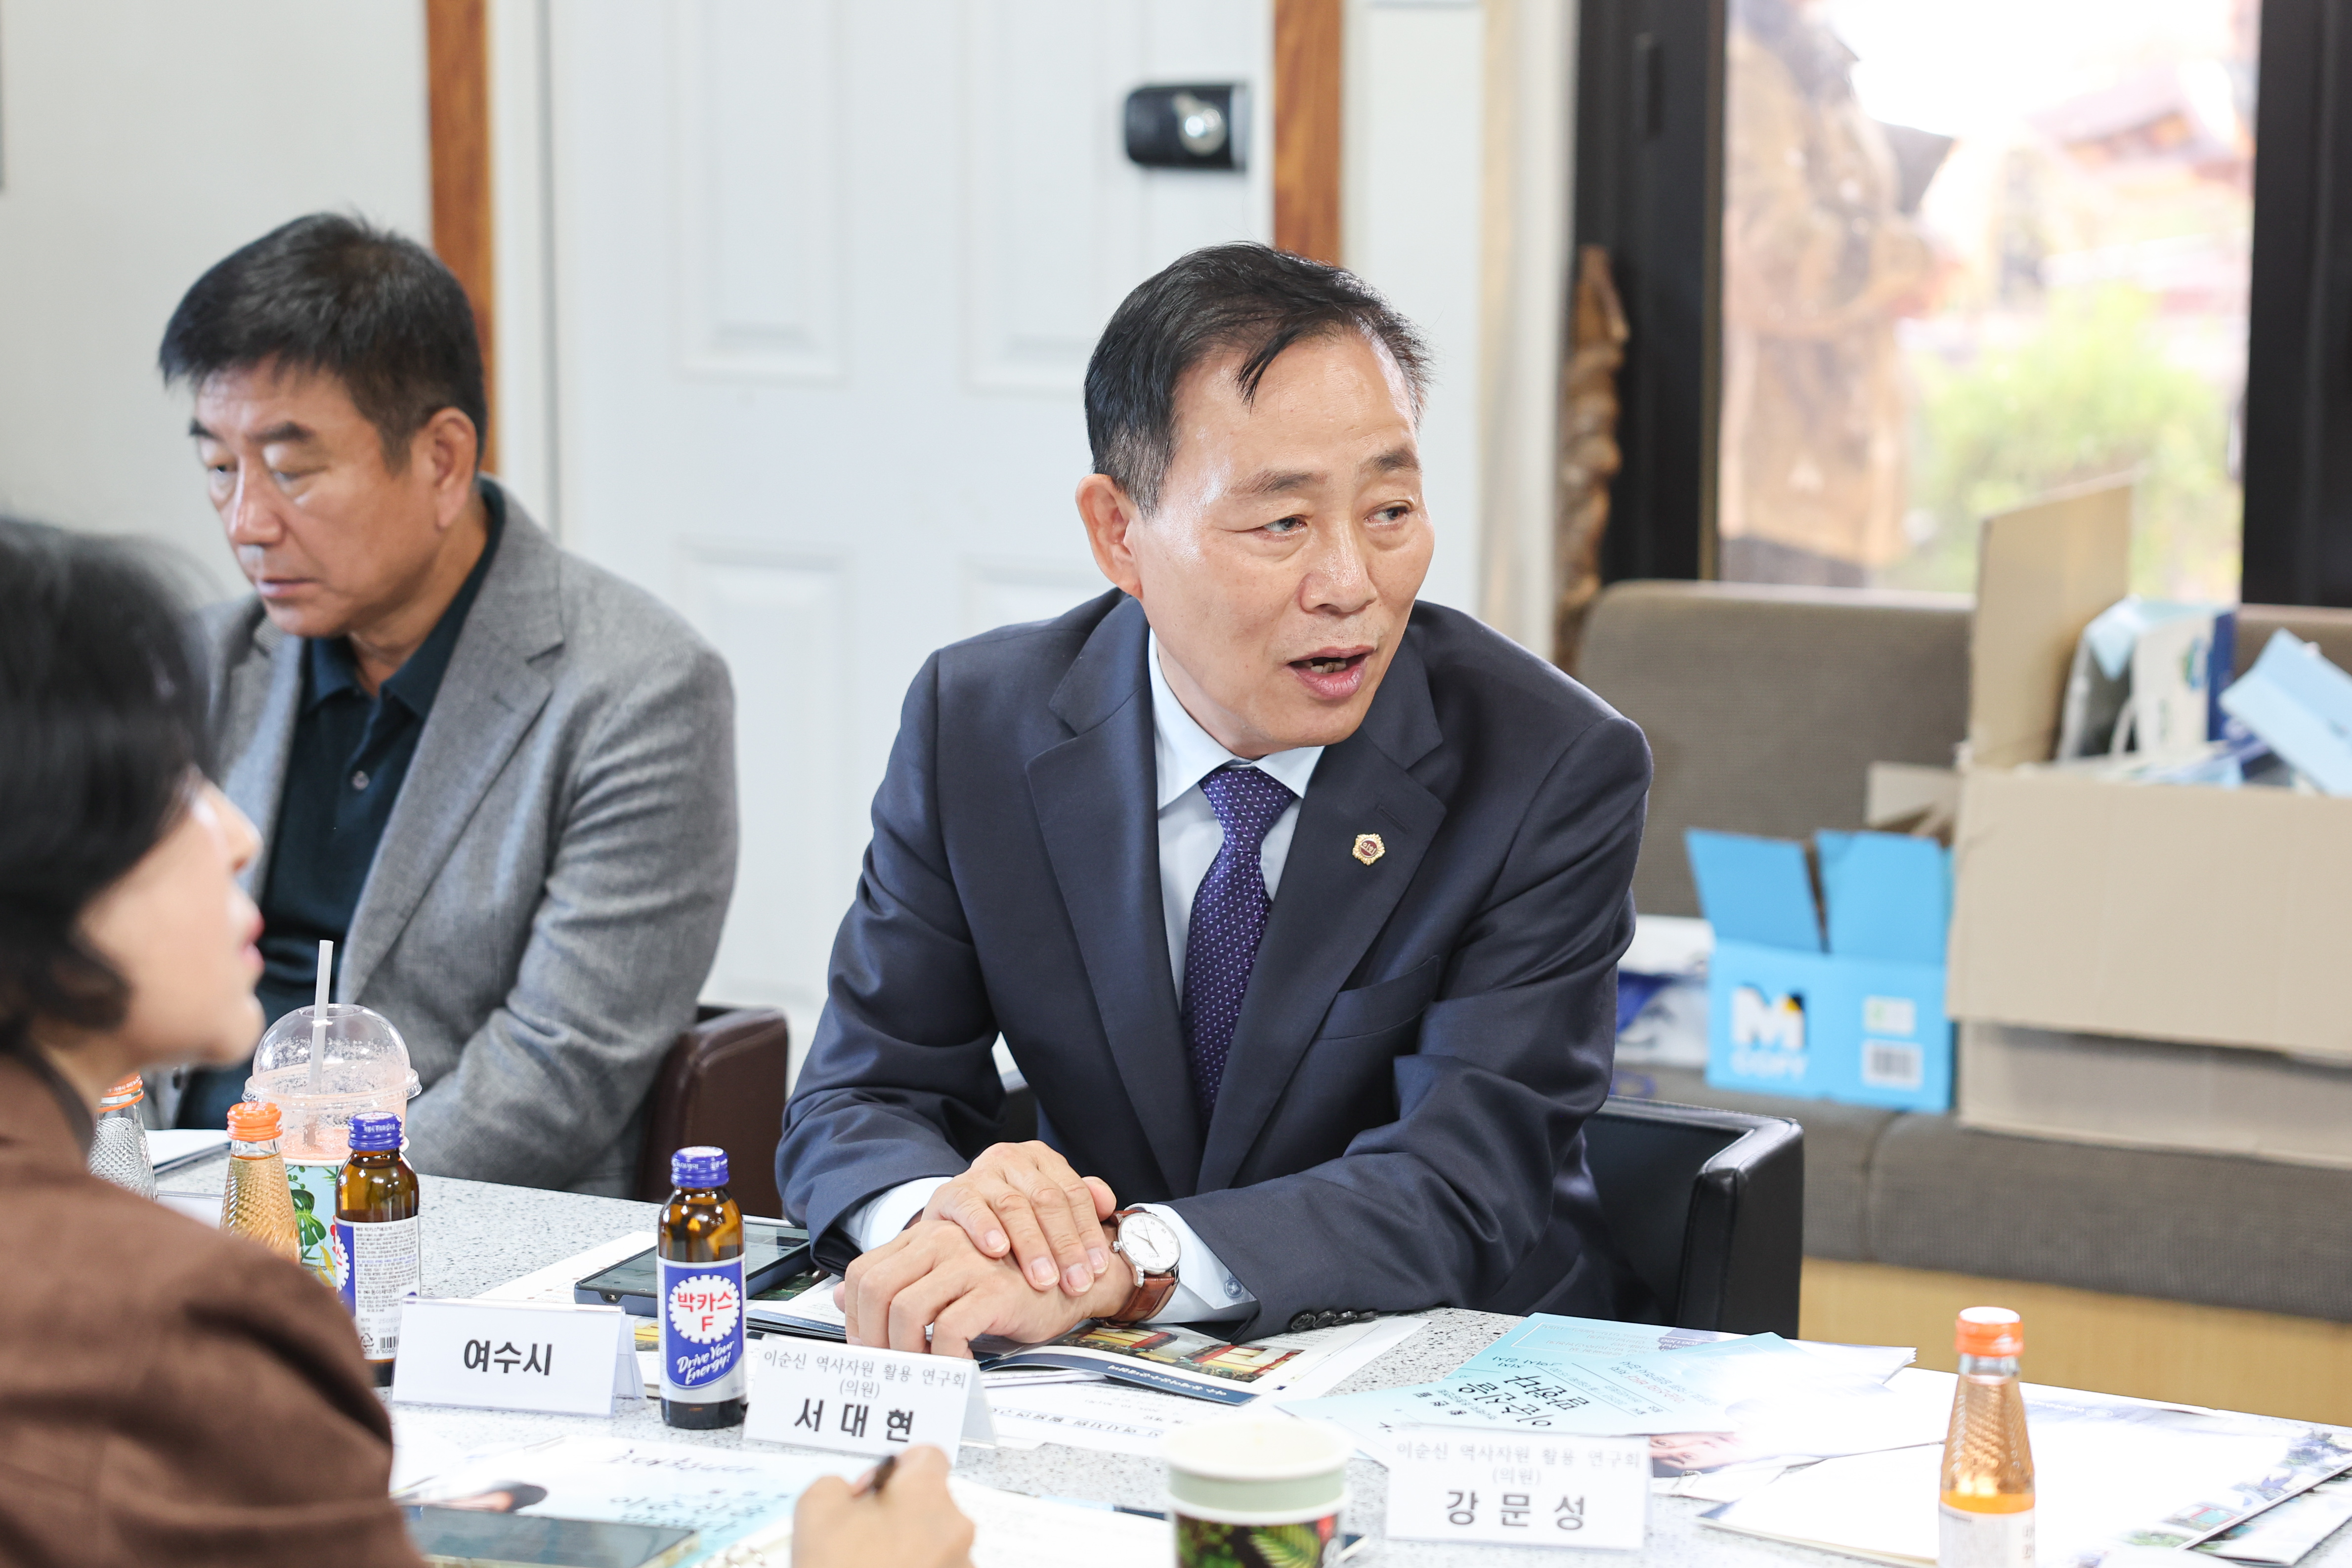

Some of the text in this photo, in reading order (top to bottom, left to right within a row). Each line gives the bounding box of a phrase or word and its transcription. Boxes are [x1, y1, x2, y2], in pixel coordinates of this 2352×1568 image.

[678, 1290, 733, 1313] 박카스
[702, 1315, 715, 1332] F
[463, 1338, 553, 1376] 여수시
[676, 1341, 735, 1374] Drive Your
[685, 1352, 731, 1385] Energy!
[764, 1350, 967, 1389] 이순신 역사자원 활용 연구회
[840, 1378, 880, 1399] (의원)
[1458, 1382, 1555, 1426] 이순신을
[1503, 1375, 1590, 1410] 말한다
[1397, 1441, 1641, 1468] 이순신 역사자원 활용 연구회
[1492, 1466, 1542, 1486] (의원)
